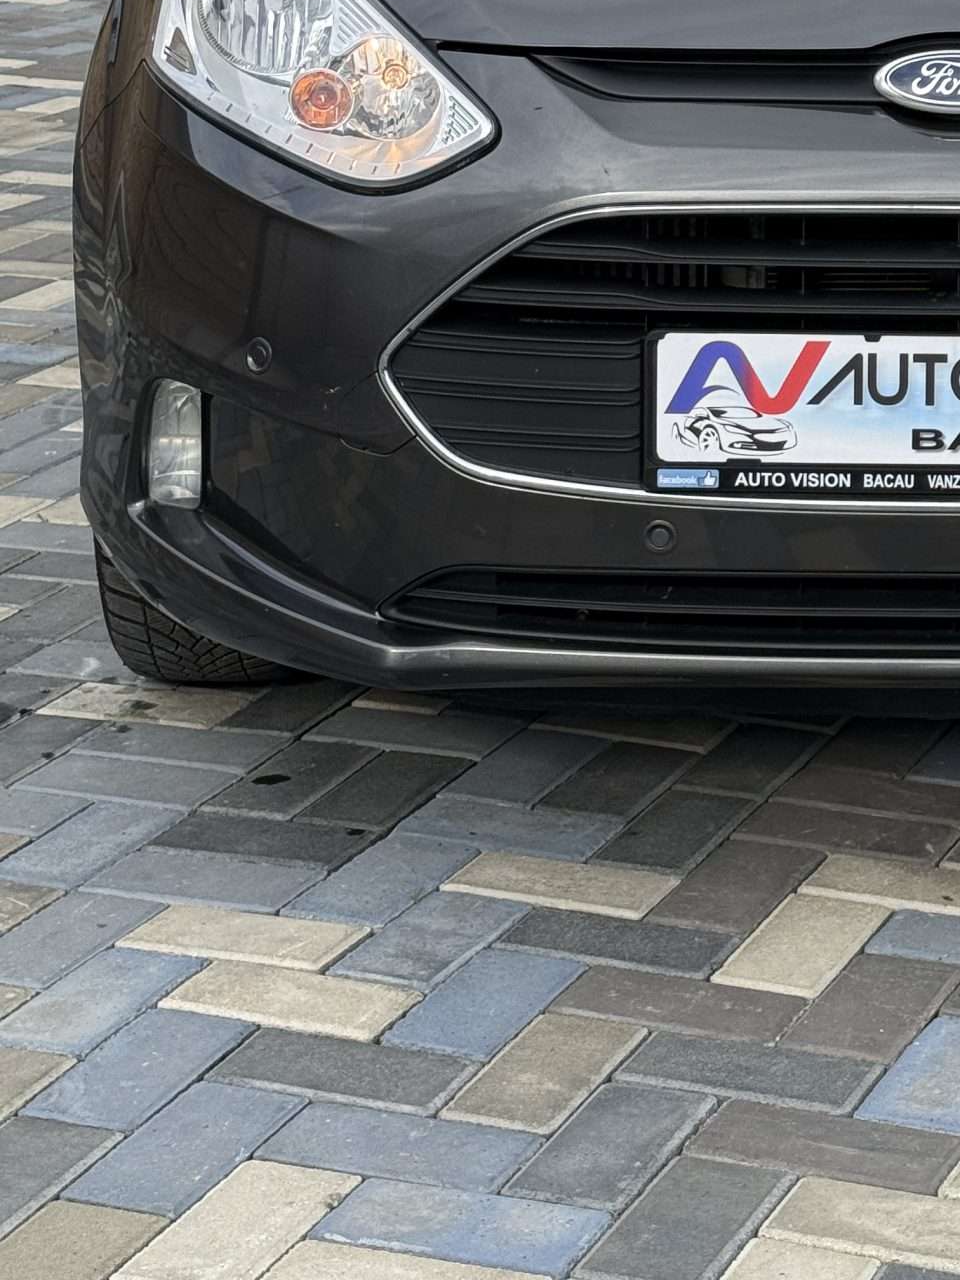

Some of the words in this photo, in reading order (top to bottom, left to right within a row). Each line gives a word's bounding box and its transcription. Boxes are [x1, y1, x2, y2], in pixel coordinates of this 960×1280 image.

[734, 472, 791, 488] AUTO
[791, 472, 851, 488] VISION
[863, 473, 915, 489] BACAU
